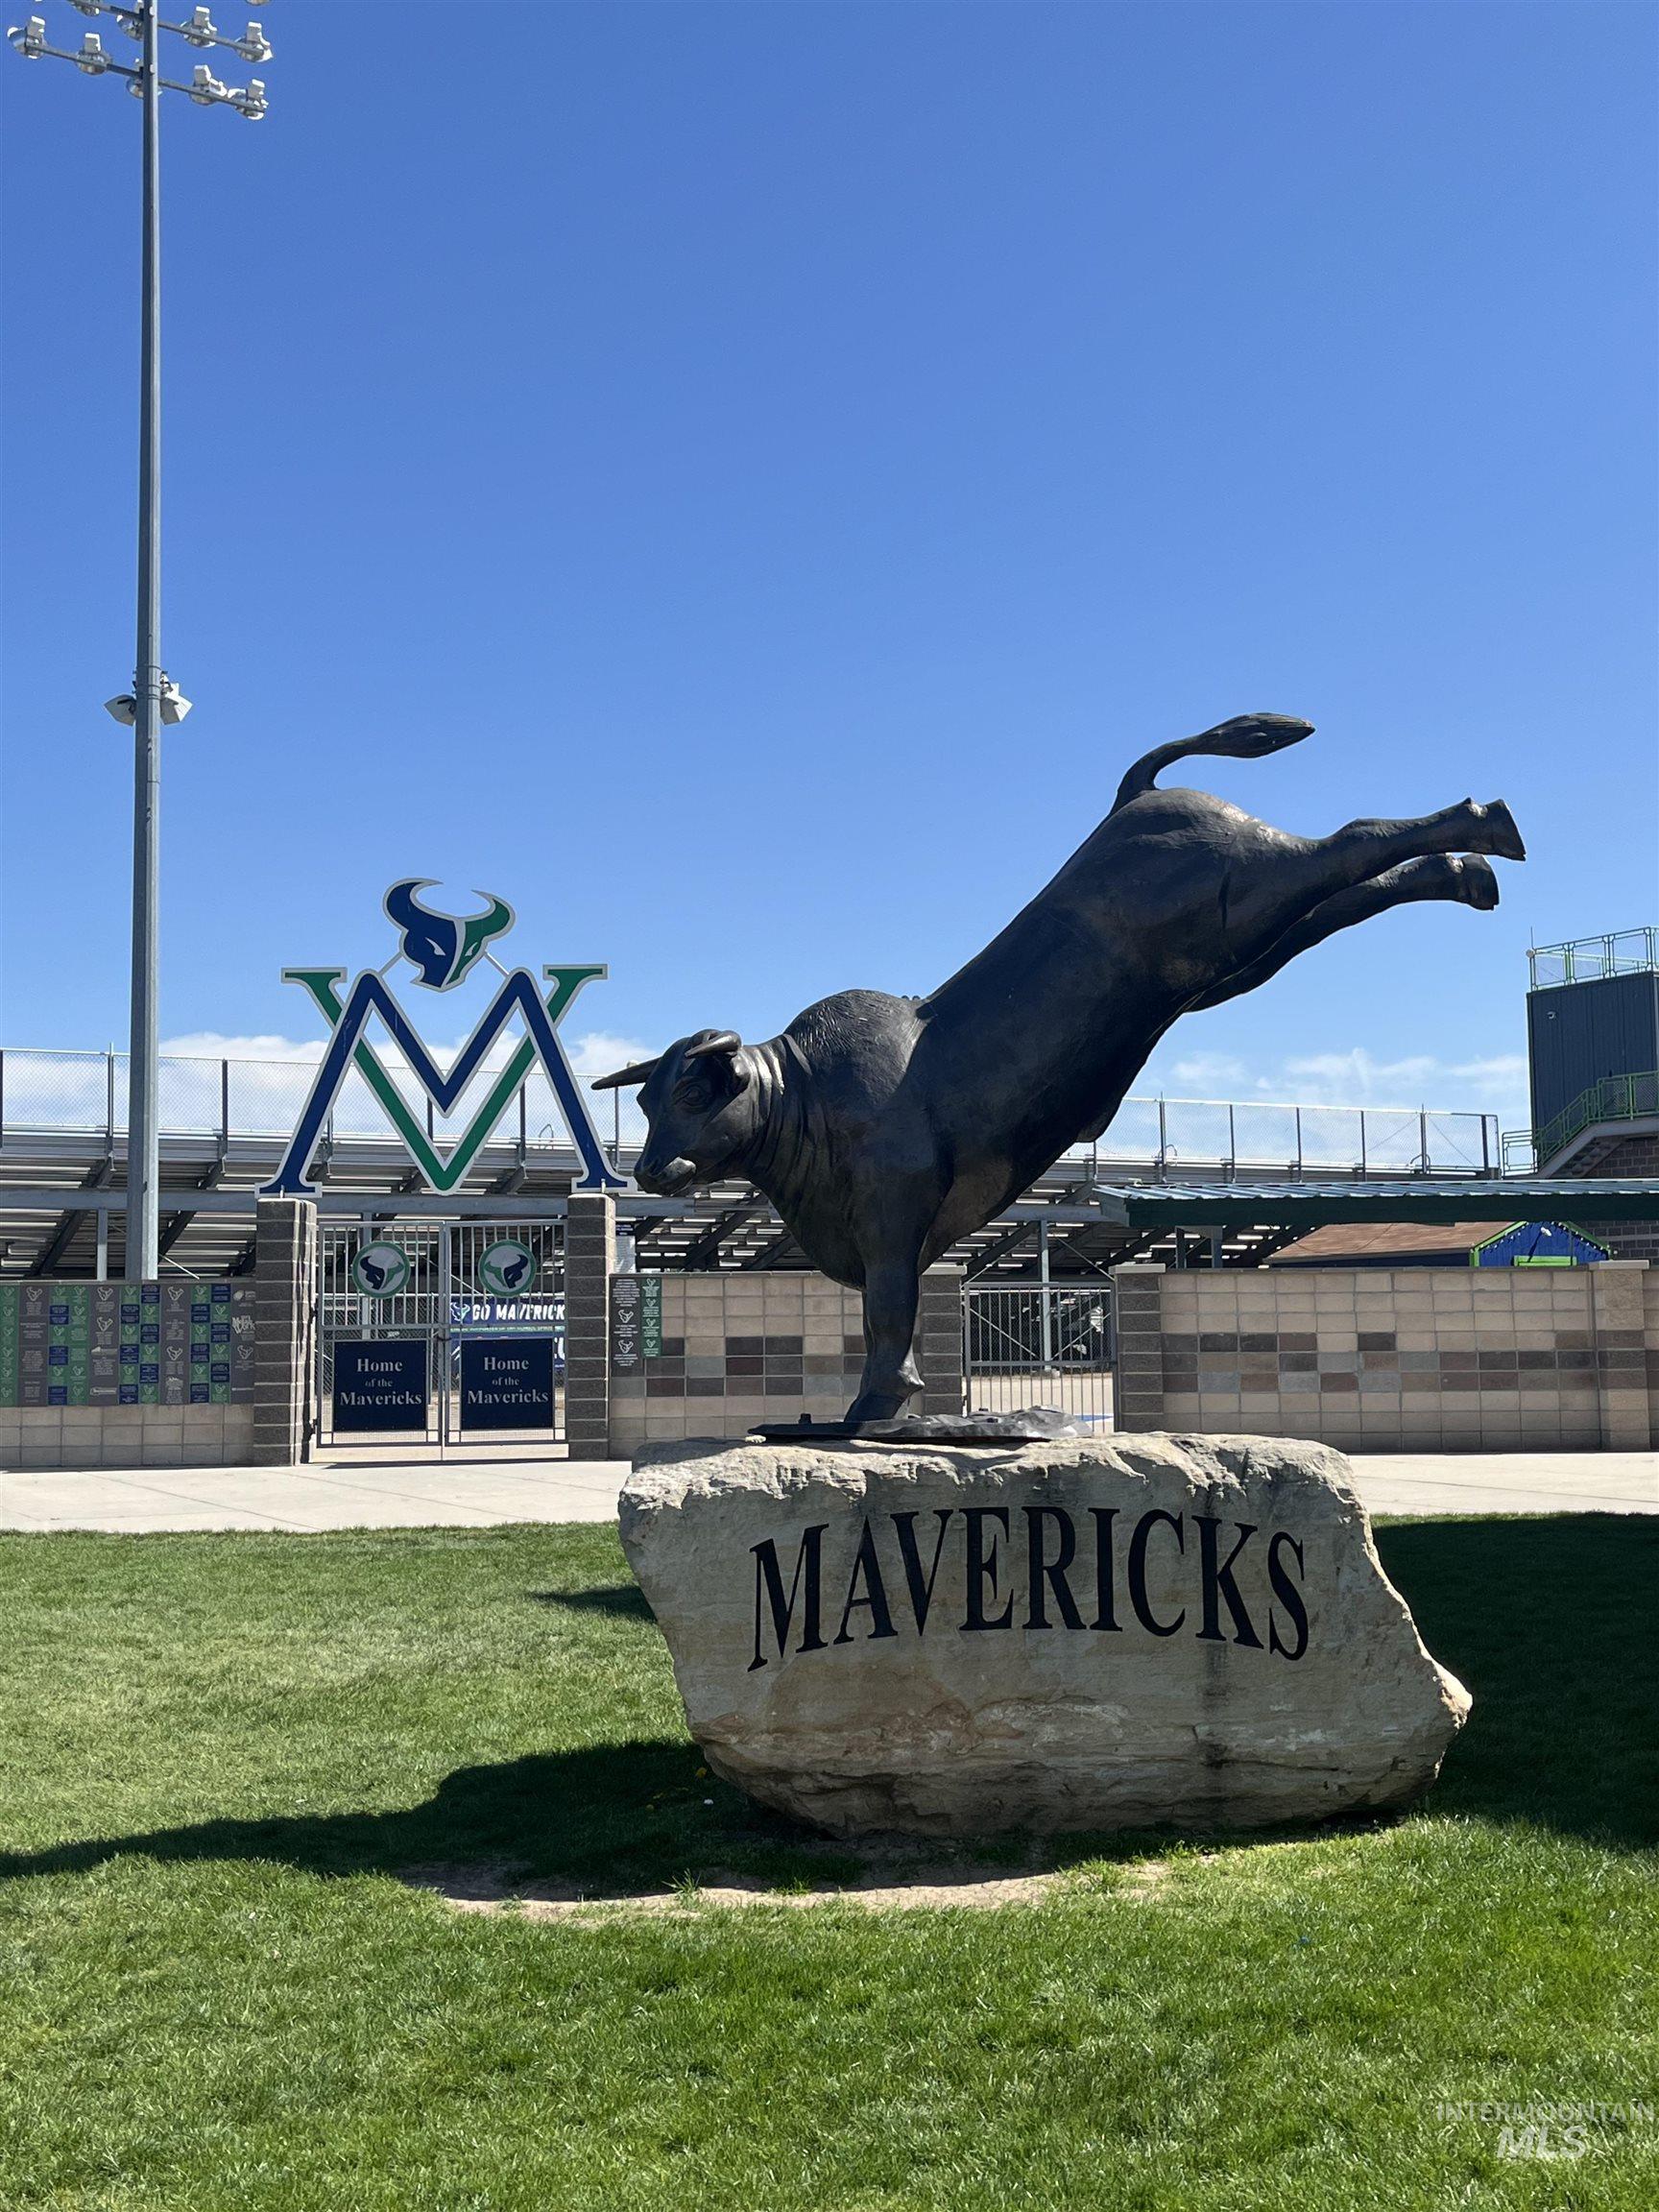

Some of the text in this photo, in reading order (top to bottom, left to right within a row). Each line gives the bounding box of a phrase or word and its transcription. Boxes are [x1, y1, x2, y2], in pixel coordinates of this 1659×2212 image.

[472, 1304, 491, 1321] GO
[356, 1358, 403, 1372] Home
[484, 1357, 530, 1371] Home
[365, 1378, 394, 1388] of the
[492, 1376, 520, 1386] of the
[340, 1390, 422, 1406] Mavericks
[468, 1388, 550, 1405] Mavericks
[748, 1505, 1310, 1672] MAVERICKS
